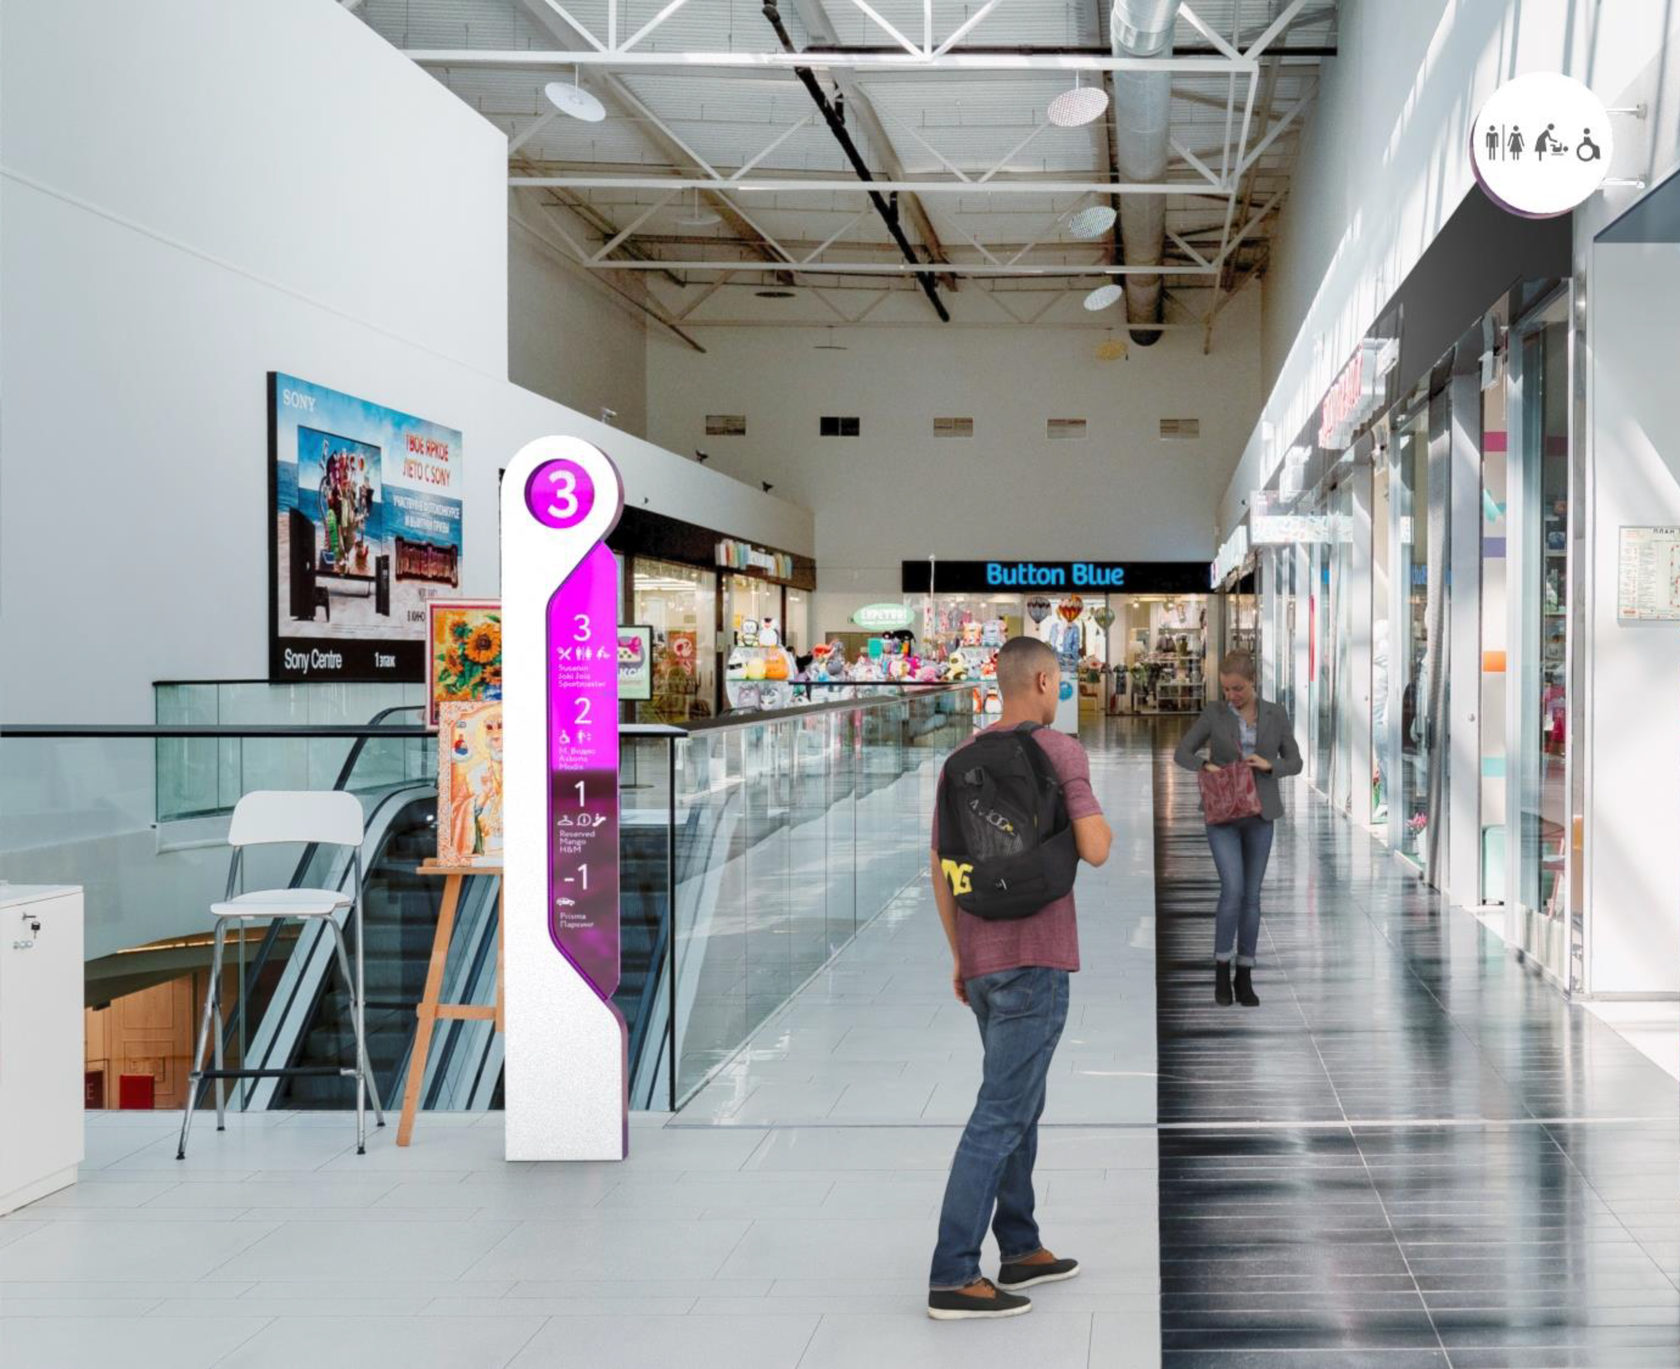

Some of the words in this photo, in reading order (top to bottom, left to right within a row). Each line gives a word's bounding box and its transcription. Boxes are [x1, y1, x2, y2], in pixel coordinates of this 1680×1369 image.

[283, 389, 316, 412] SONY
[547, 470, 579, 519] 3
[986, 562, 1065, 585] Button
[1072, 563, 1125, 585] Blue
[573, 614, 592, 641] 3
[284, 648, 310, 674] Sony
[311, 648, 342, 669] Centre
[375, 651, 379, 667] 1
[574, 697, 592, 725] 2
[574, 780, 585, 807] 1
[564, 863, 588, 891] -1
